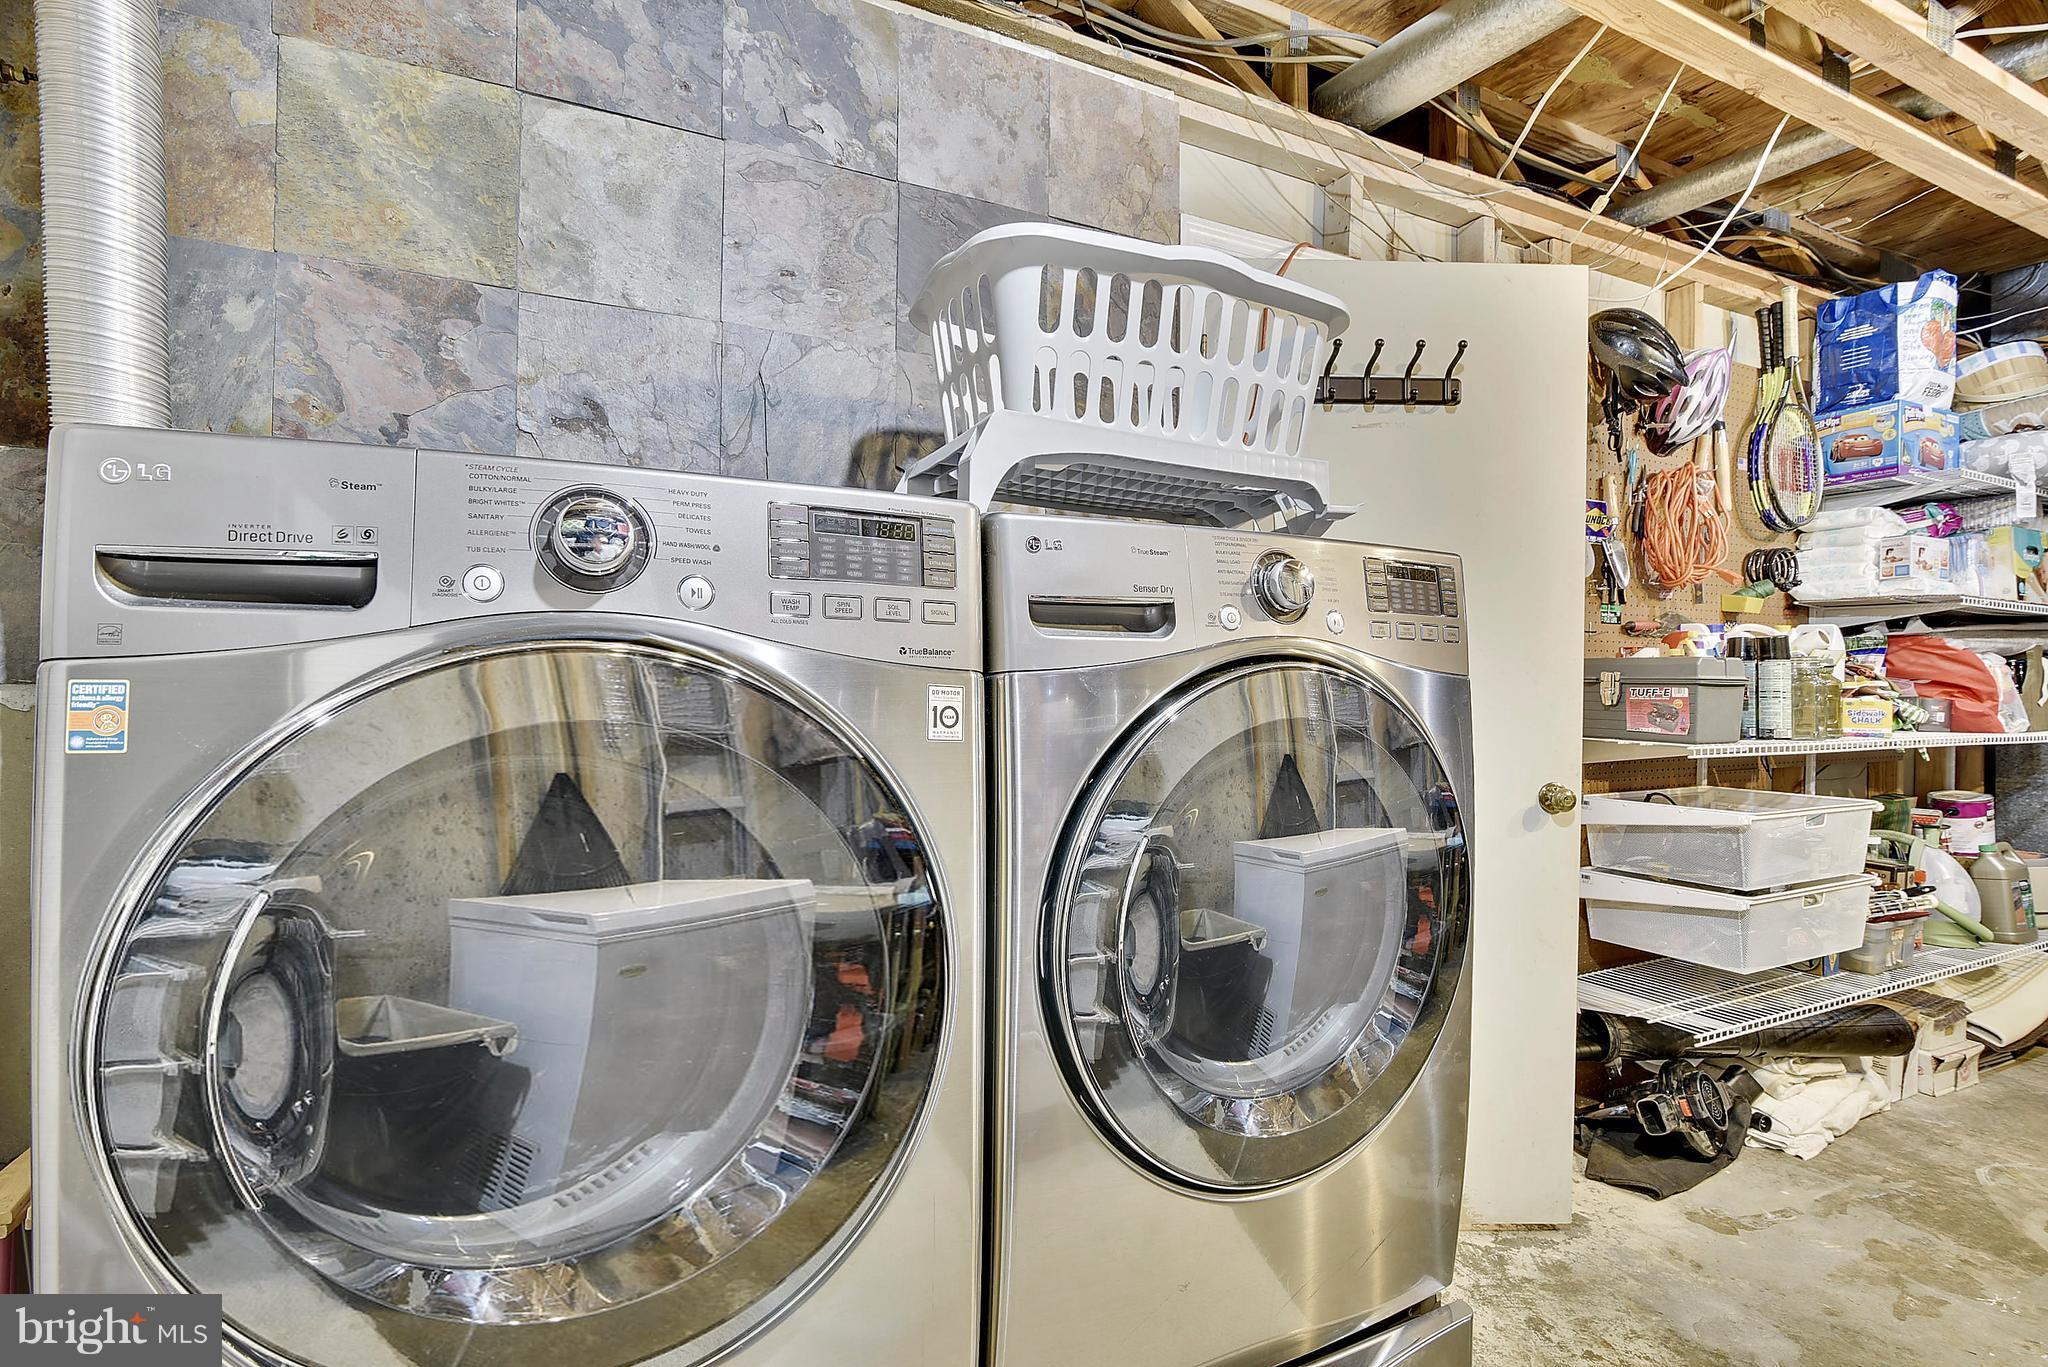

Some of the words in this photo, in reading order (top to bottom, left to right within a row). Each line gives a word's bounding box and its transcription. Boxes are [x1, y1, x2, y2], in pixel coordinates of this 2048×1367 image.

[136, 463, 171, 481] LG
[495, 465, 519, 474] CYCLE
[468, 473, 532, 483] COTTON/NORMAL
[468, 485, 518, 494] BULKY/LARGE
[668, 488, 690, 498] HEAVY
[690, 490, 709, 498] DUTY
[468, 498, 497, 506] BRIGHT
[691, 502, 712, 510] PRESS
[467, 512, 505, 520] SANITARY
[677, 512, 712, 521] DELICATES
[685, 527, 712, 535] TOWELS
[228, 529, 273, 543] Direct
[276, 531, 314, 544] Drive
[662, 540, 677, 548] HAND
[1045, 539, 1063, 551] LG
[670, 556, 690, 565] SPEED
[690, 558, 712, 566] WASH
[1133, 583, 1159, 594] Sensor
[1160, 584, 1174, 595] Dry
[887, 603, 901, 611] SOIL
[930, 609, 950, 617] SIGNAL
[72, 684, 126, 695] CERTIFIED
[1630, 687, 1671, 698] TUFF-E
[932, 705, 960, 729] 10
[1847, 709, 1886, 718] Sidewalk
[1851, 716, 1882, 724] CHALK
